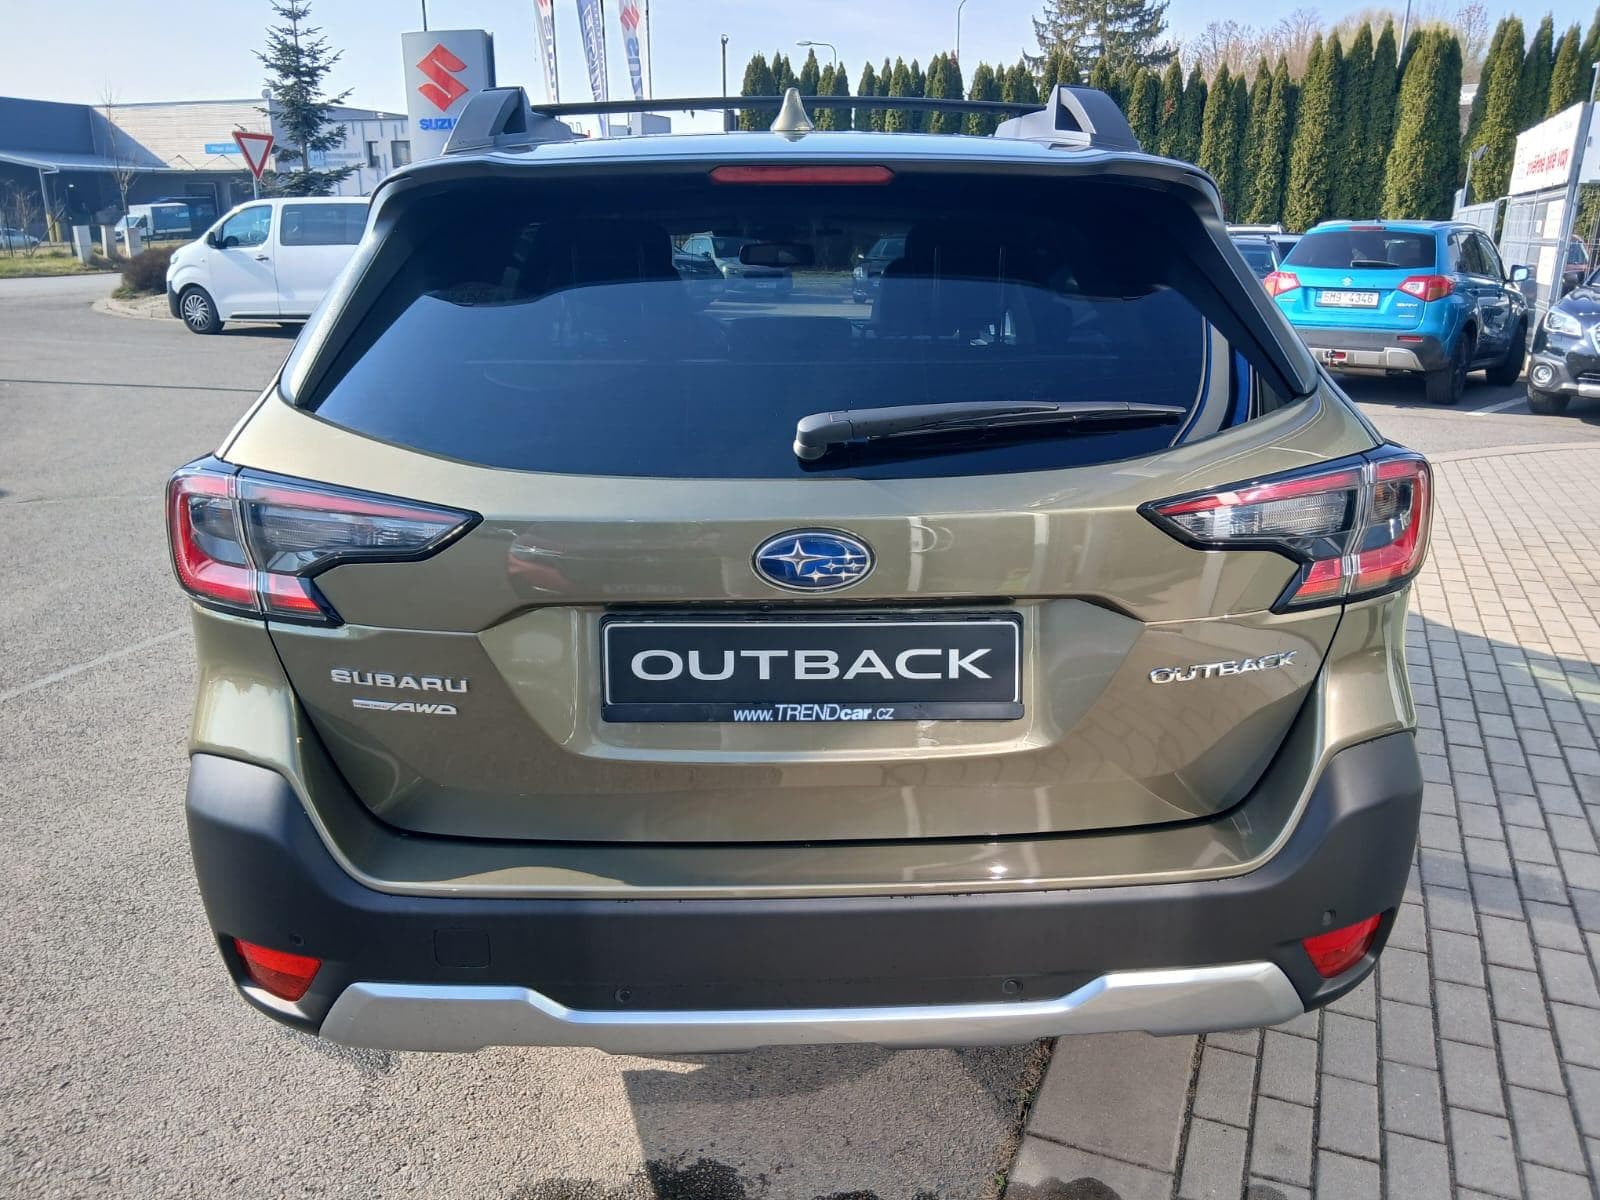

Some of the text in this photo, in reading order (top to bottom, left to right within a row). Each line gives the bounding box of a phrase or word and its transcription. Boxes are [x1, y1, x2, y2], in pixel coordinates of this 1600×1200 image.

[631, 648, 993, 681] OUTBACK
[1150, 651, 1297, 684] OUTBACK
[330, 668, 468, 693] SUBARU
[733, 704, 895, 721] www.TRENDcar.cz
